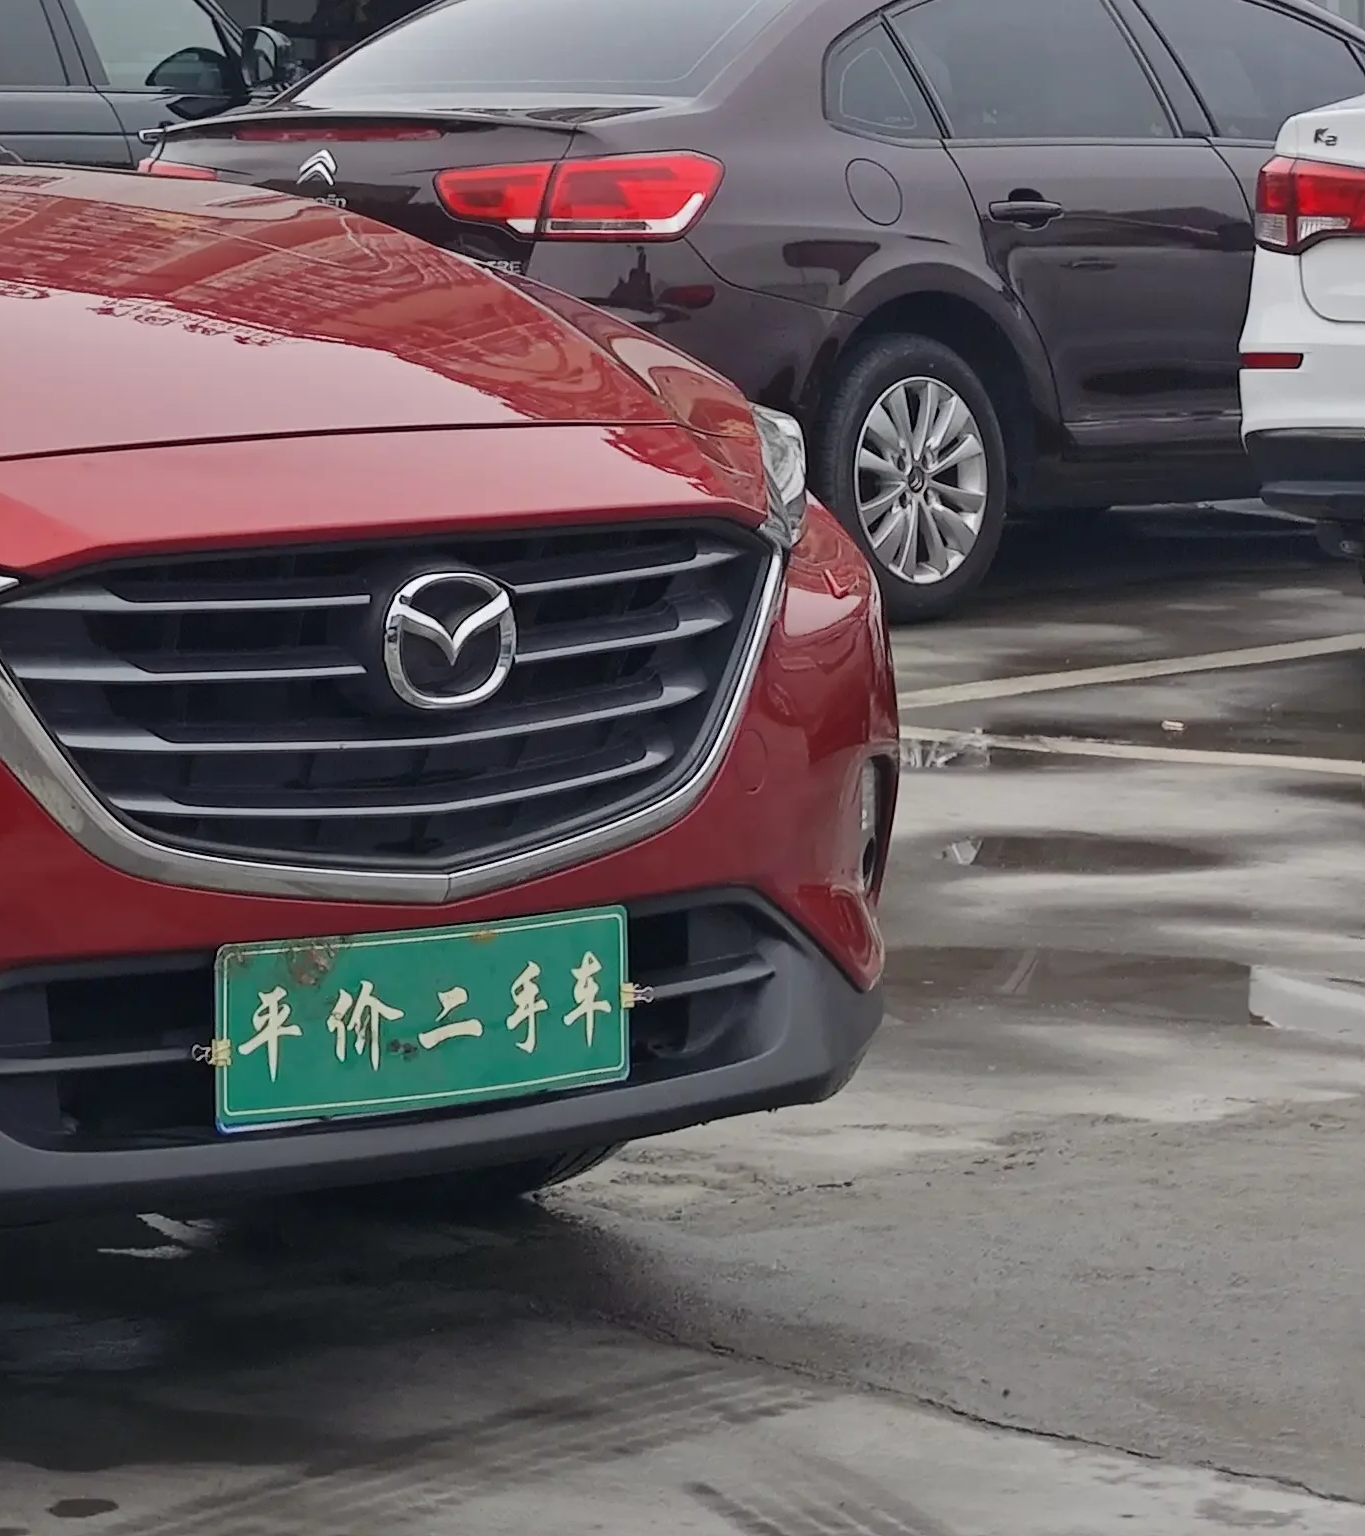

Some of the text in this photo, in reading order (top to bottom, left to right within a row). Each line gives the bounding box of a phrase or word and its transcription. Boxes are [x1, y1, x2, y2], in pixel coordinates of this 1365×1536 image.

[1313, 127, 1338, 147] K2
[238, 950, 612, 1084] 平价二手车
